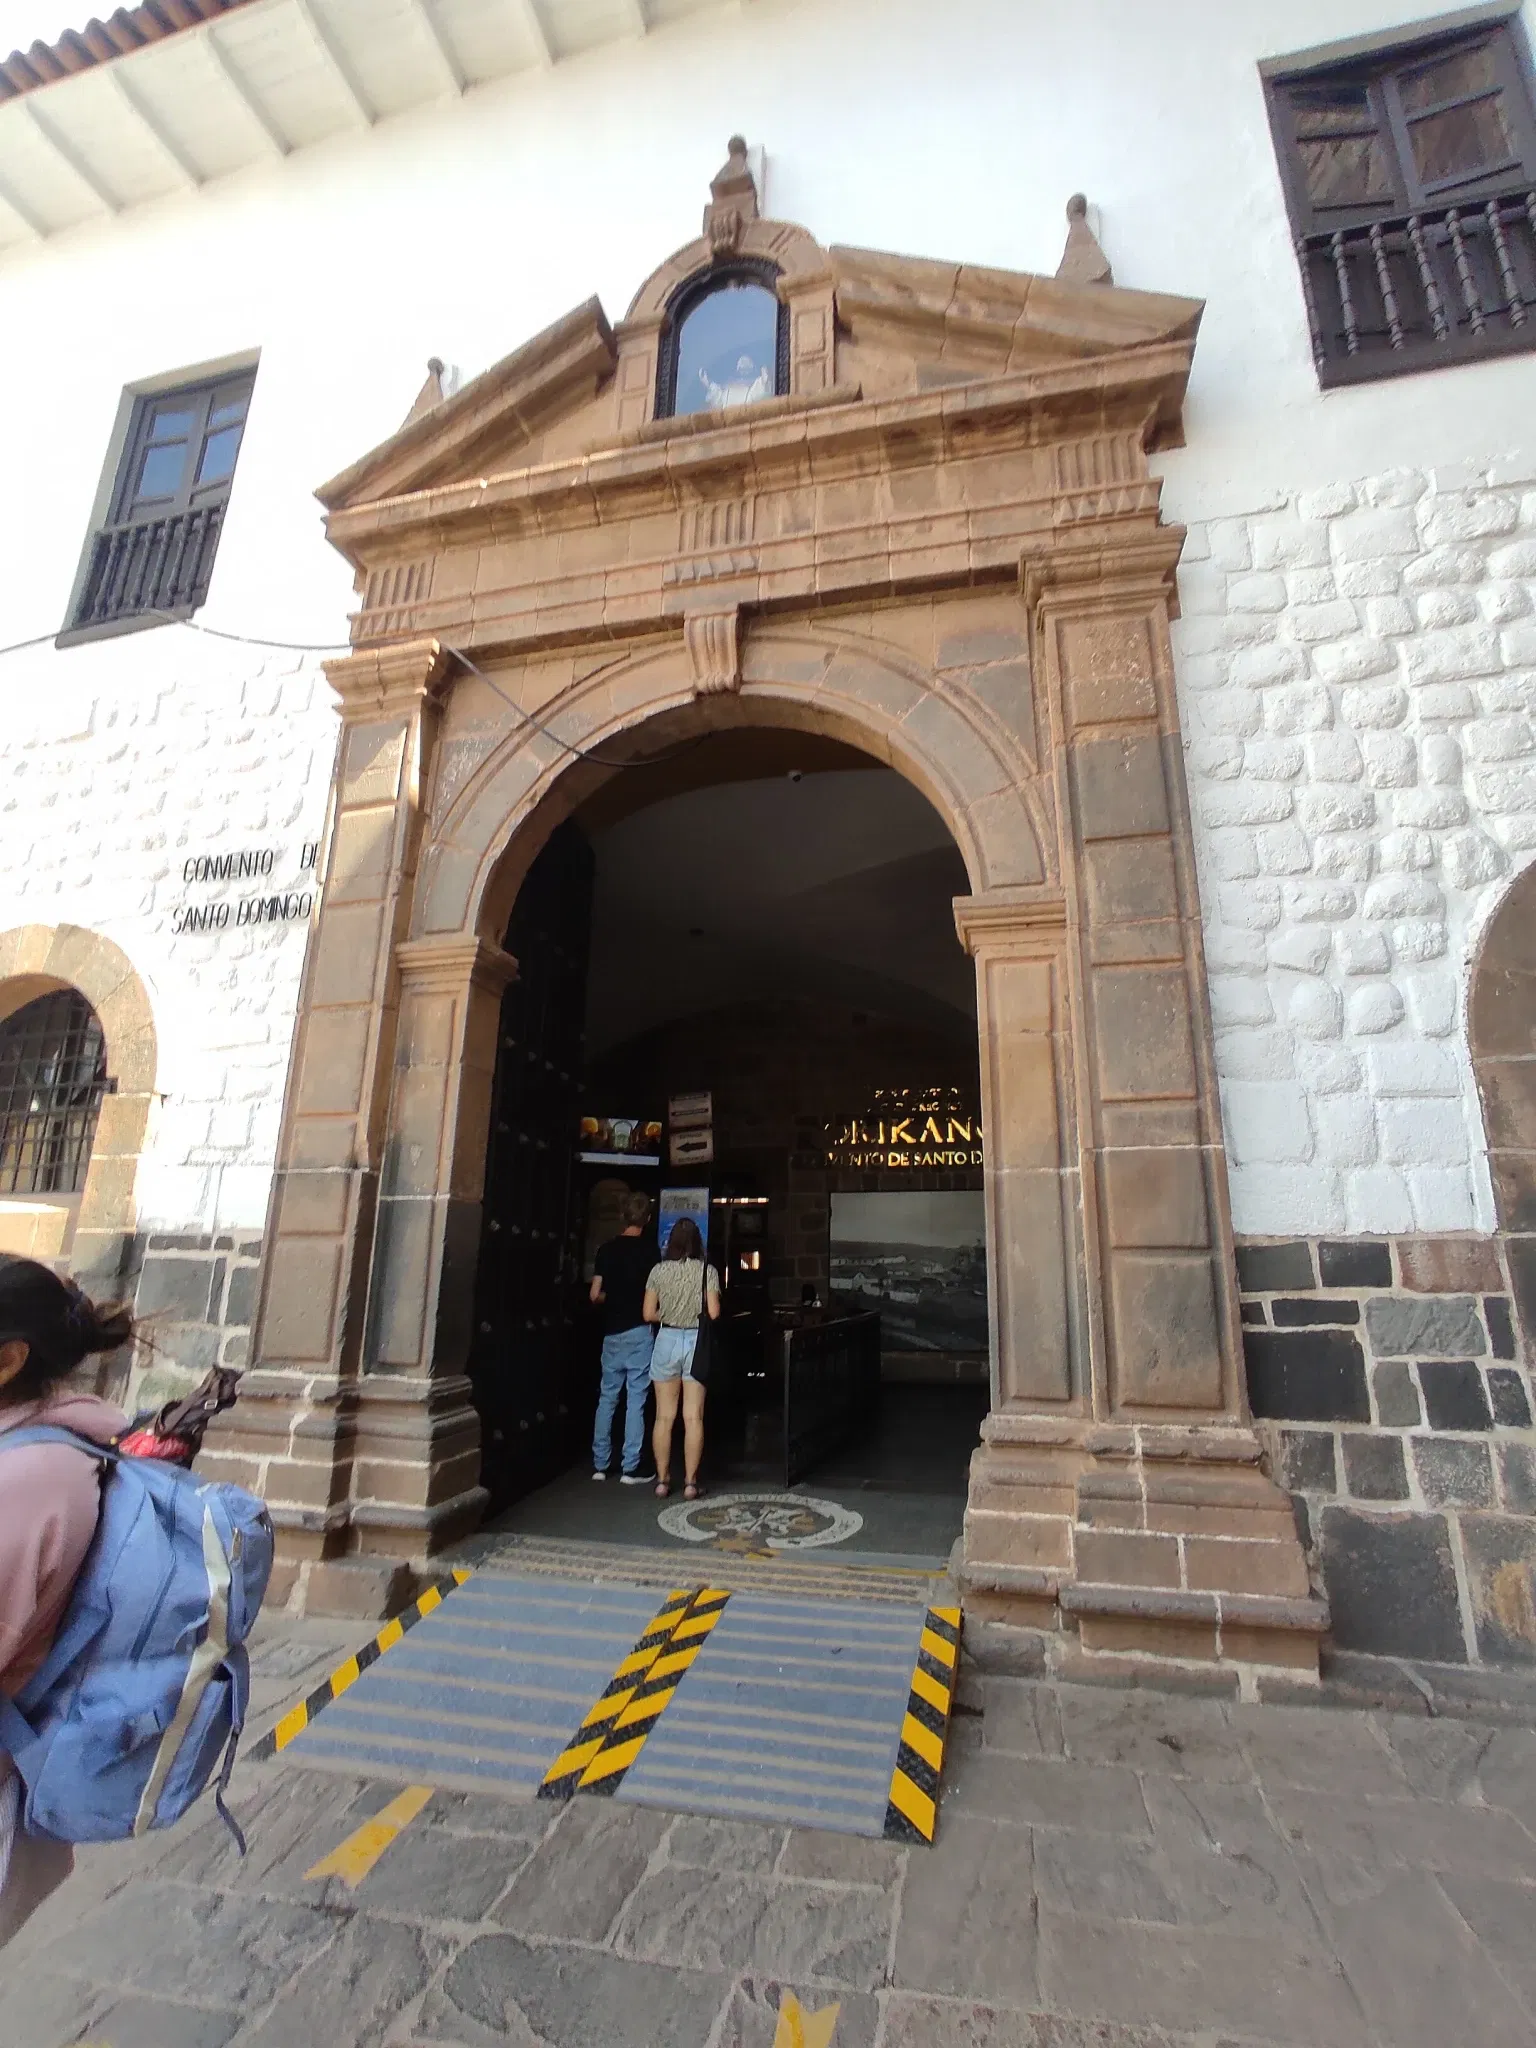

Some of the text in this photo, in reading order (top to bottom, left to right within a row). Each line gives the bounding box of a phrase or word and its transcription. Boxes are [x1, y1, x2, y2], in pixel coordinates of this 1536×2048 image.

[183, 849, 274, 883] CONVENTO
[171, 892, 312, 935] SANTO DOMINGO
[888, 1151, 910, 1167] DE
[914, 1151, 967, 1166] SANTO
